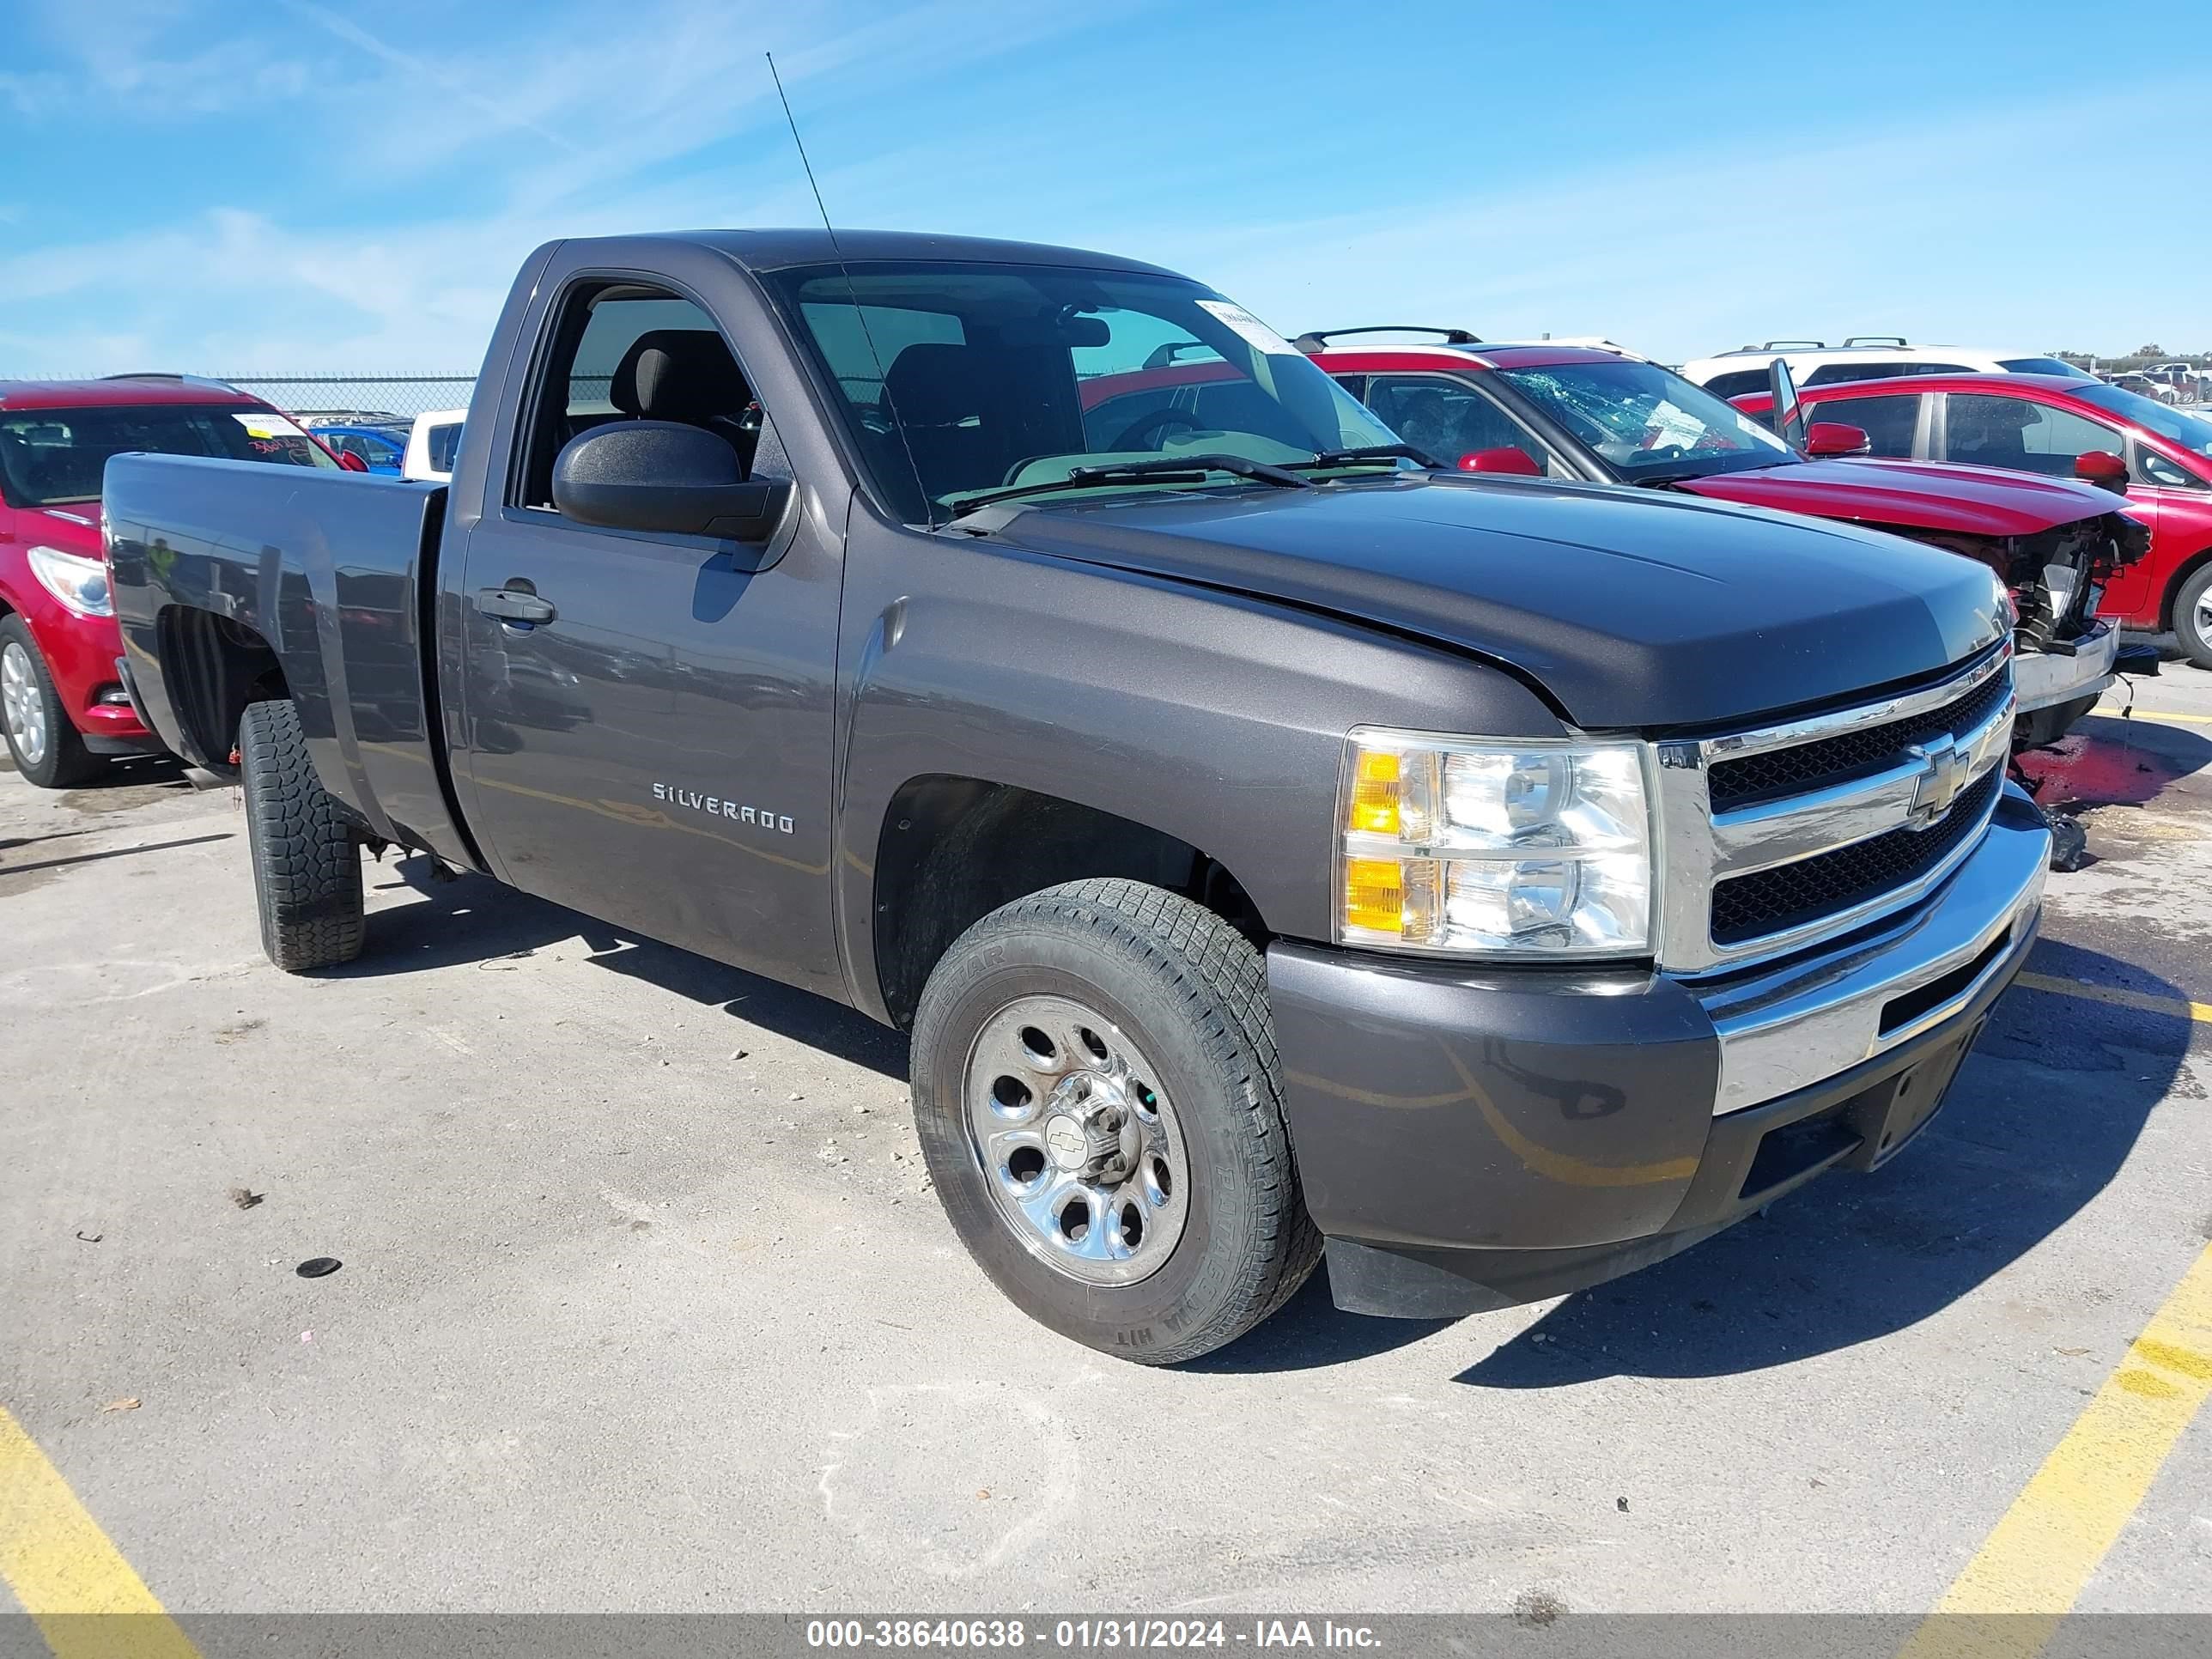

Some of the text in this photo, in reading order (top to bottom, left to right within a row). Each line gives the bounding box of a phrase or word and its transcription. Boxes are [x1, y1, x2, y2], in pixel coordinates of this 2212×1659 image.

[653, 782, 795, 835] SILVERADO
[918, 945, 1006, 1086] MILESTAR
[1115, 1327, 1156, 1348] H/T
